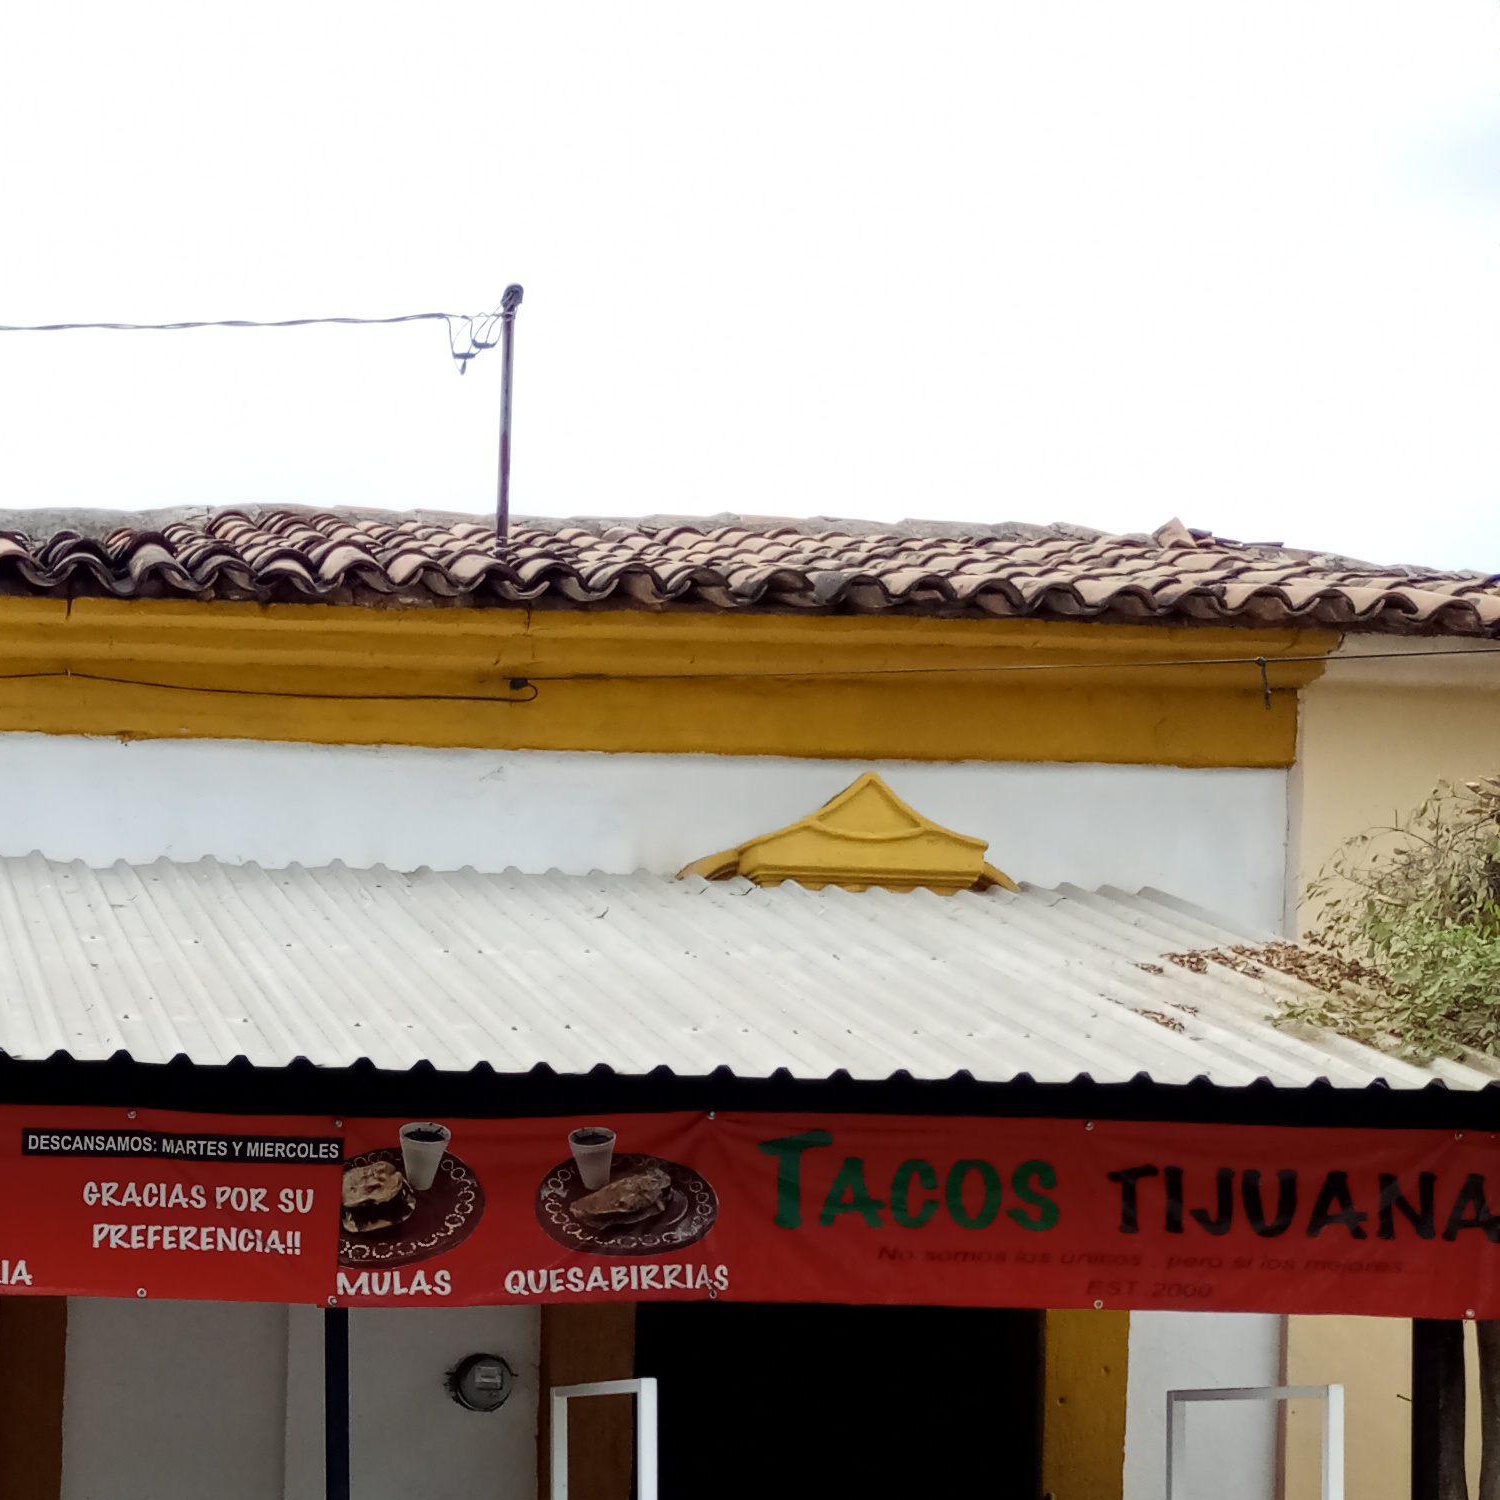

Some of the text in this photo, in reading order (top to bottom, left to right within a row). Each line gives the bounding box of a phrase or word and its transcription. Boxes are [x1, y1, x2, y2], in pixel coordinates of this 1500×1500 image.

[28, 1135, 339, 1158] DESCANSAMOS: MARTES Y MIERCOLES
[83, 1181, 314, 1213] GRACIAS POR SU
[758, 1129, 1500, 1243] TACOS TIJUANA
[92, 1223, 301, 1255] PREFERENCIA!!
[337, 1270, 452, 1296] MULAS
[505, 1265, 729, 1295] QUESABIRRIAS
